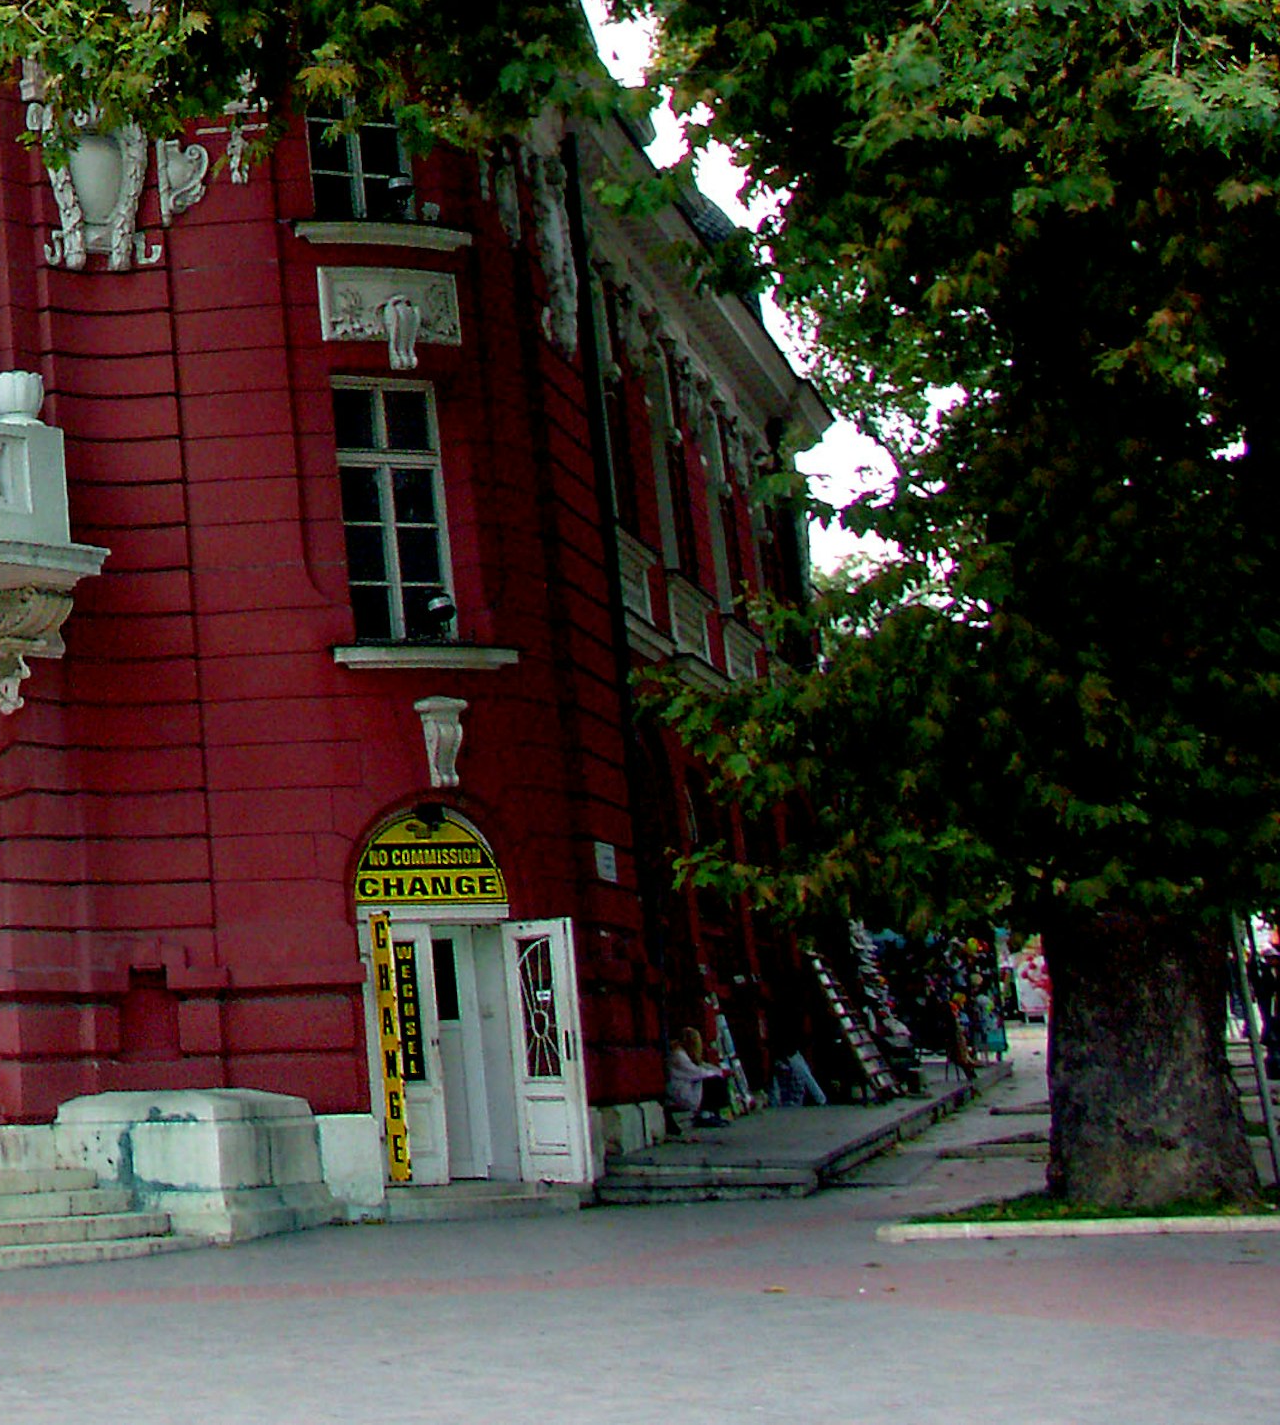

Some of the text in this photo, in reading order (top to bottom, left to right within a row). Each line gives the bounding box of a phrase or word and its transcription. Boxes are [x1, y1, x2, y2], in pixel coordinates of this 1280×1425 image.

[358, 876, 497, 897] CHANGE
[369, 848, 481, 865] NO COMMISSION
[374, 920, 404, 1163] CHANGE
[396, 946, 420, 1074] WECHSEL
